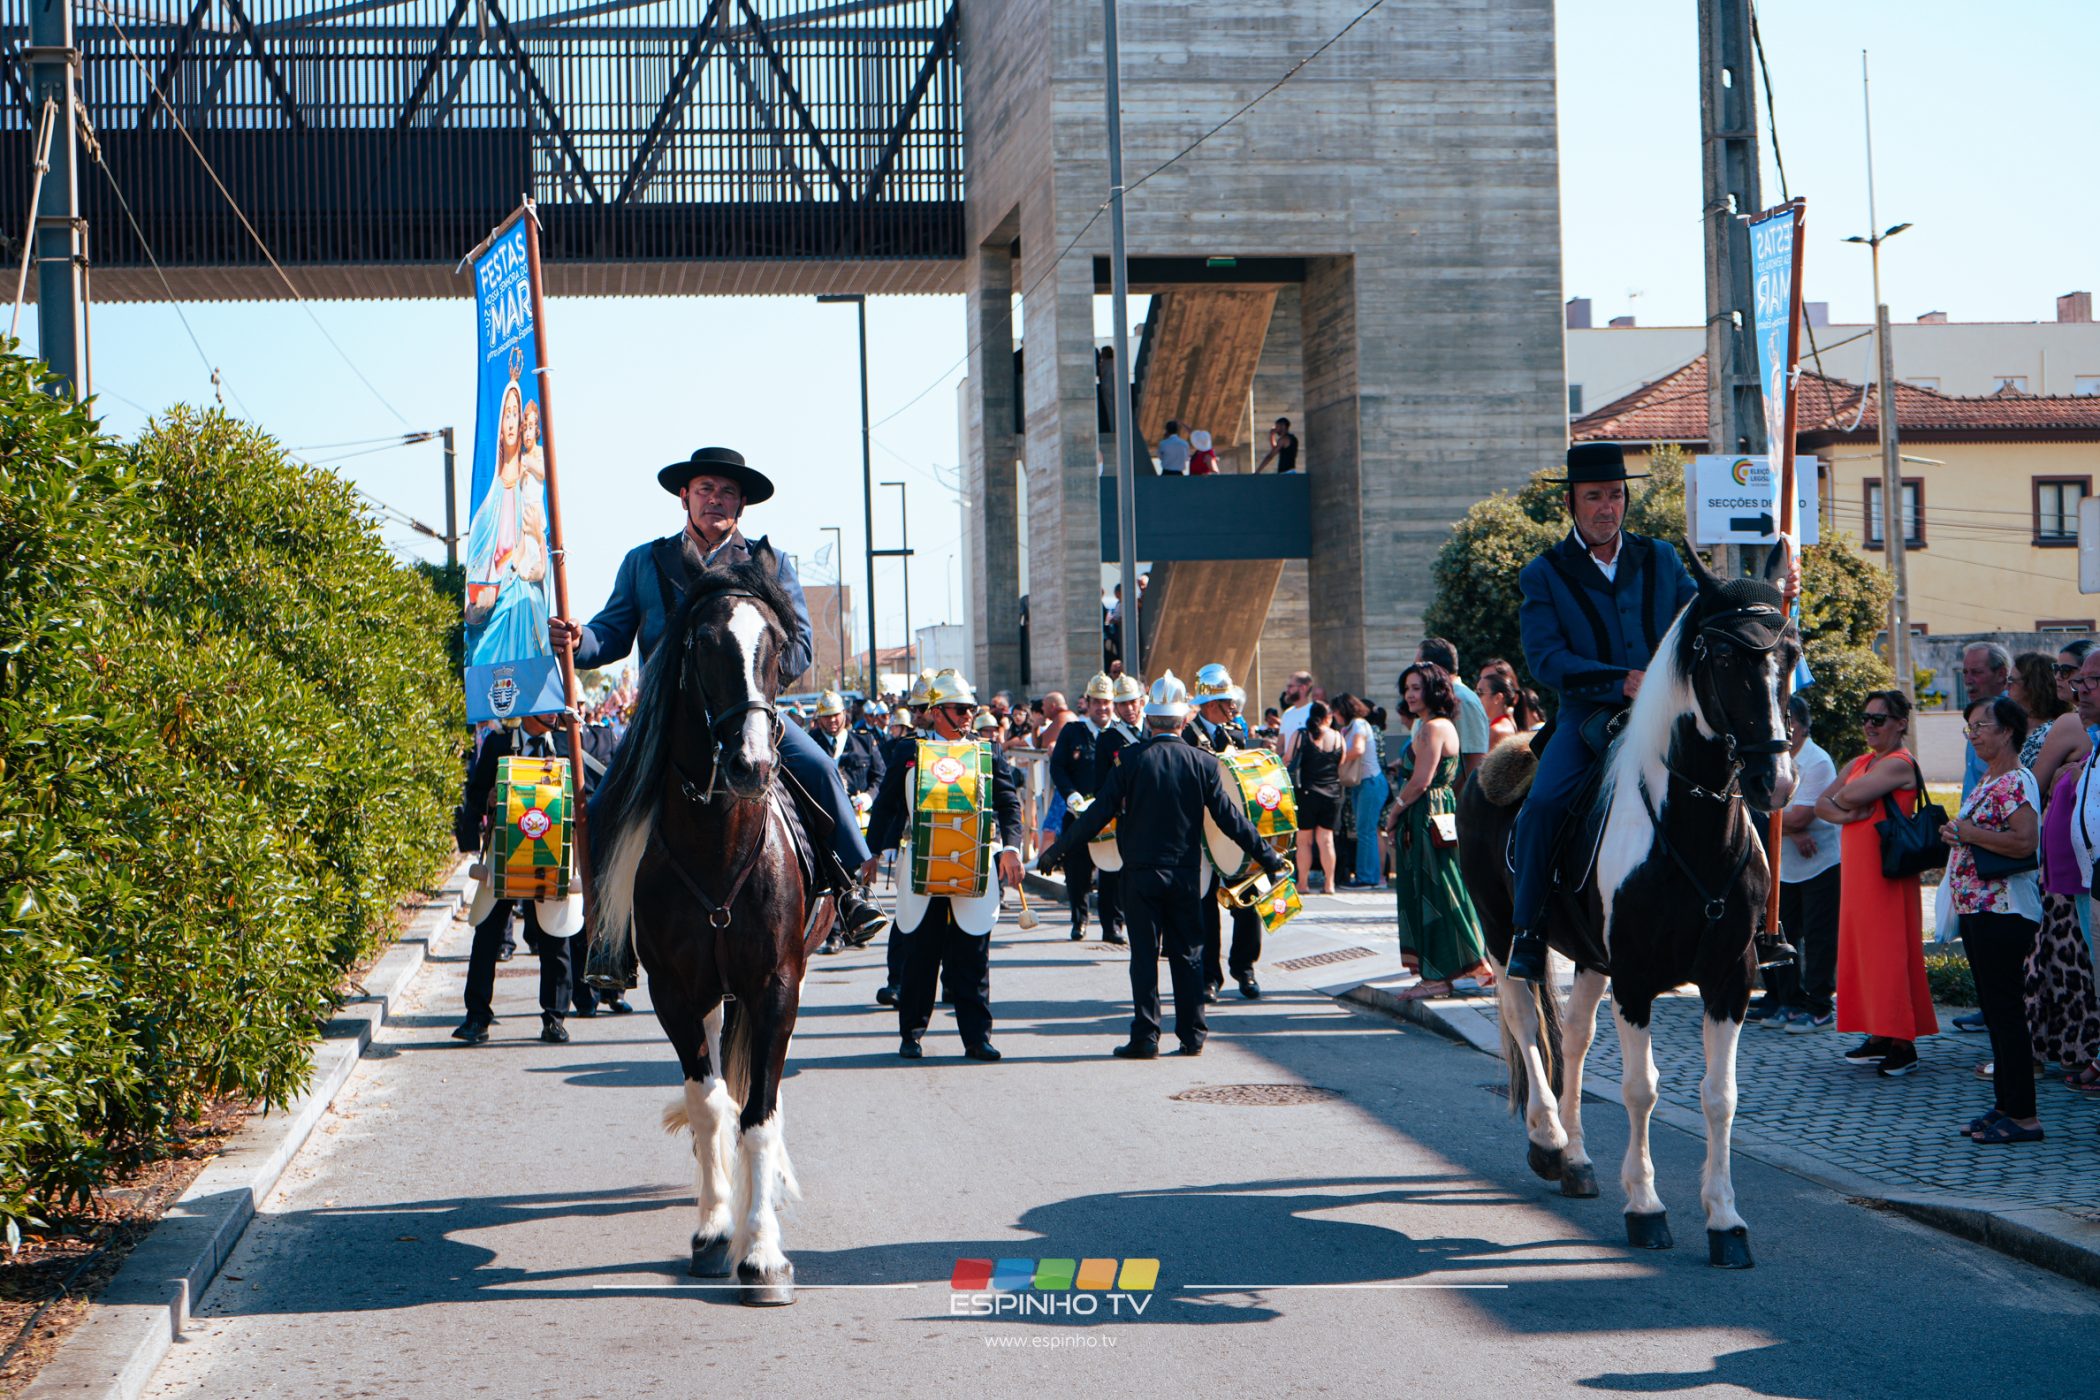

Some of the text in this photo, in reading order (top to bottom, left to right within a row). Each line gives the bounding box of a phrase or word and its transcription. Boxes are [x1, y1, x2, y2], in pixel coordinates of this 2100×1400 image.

[479, 231, 526, 295] FESTAS
[490, 276, 533, 348] MAR
[1708, 497, 1758, 509] SECÇÕES
